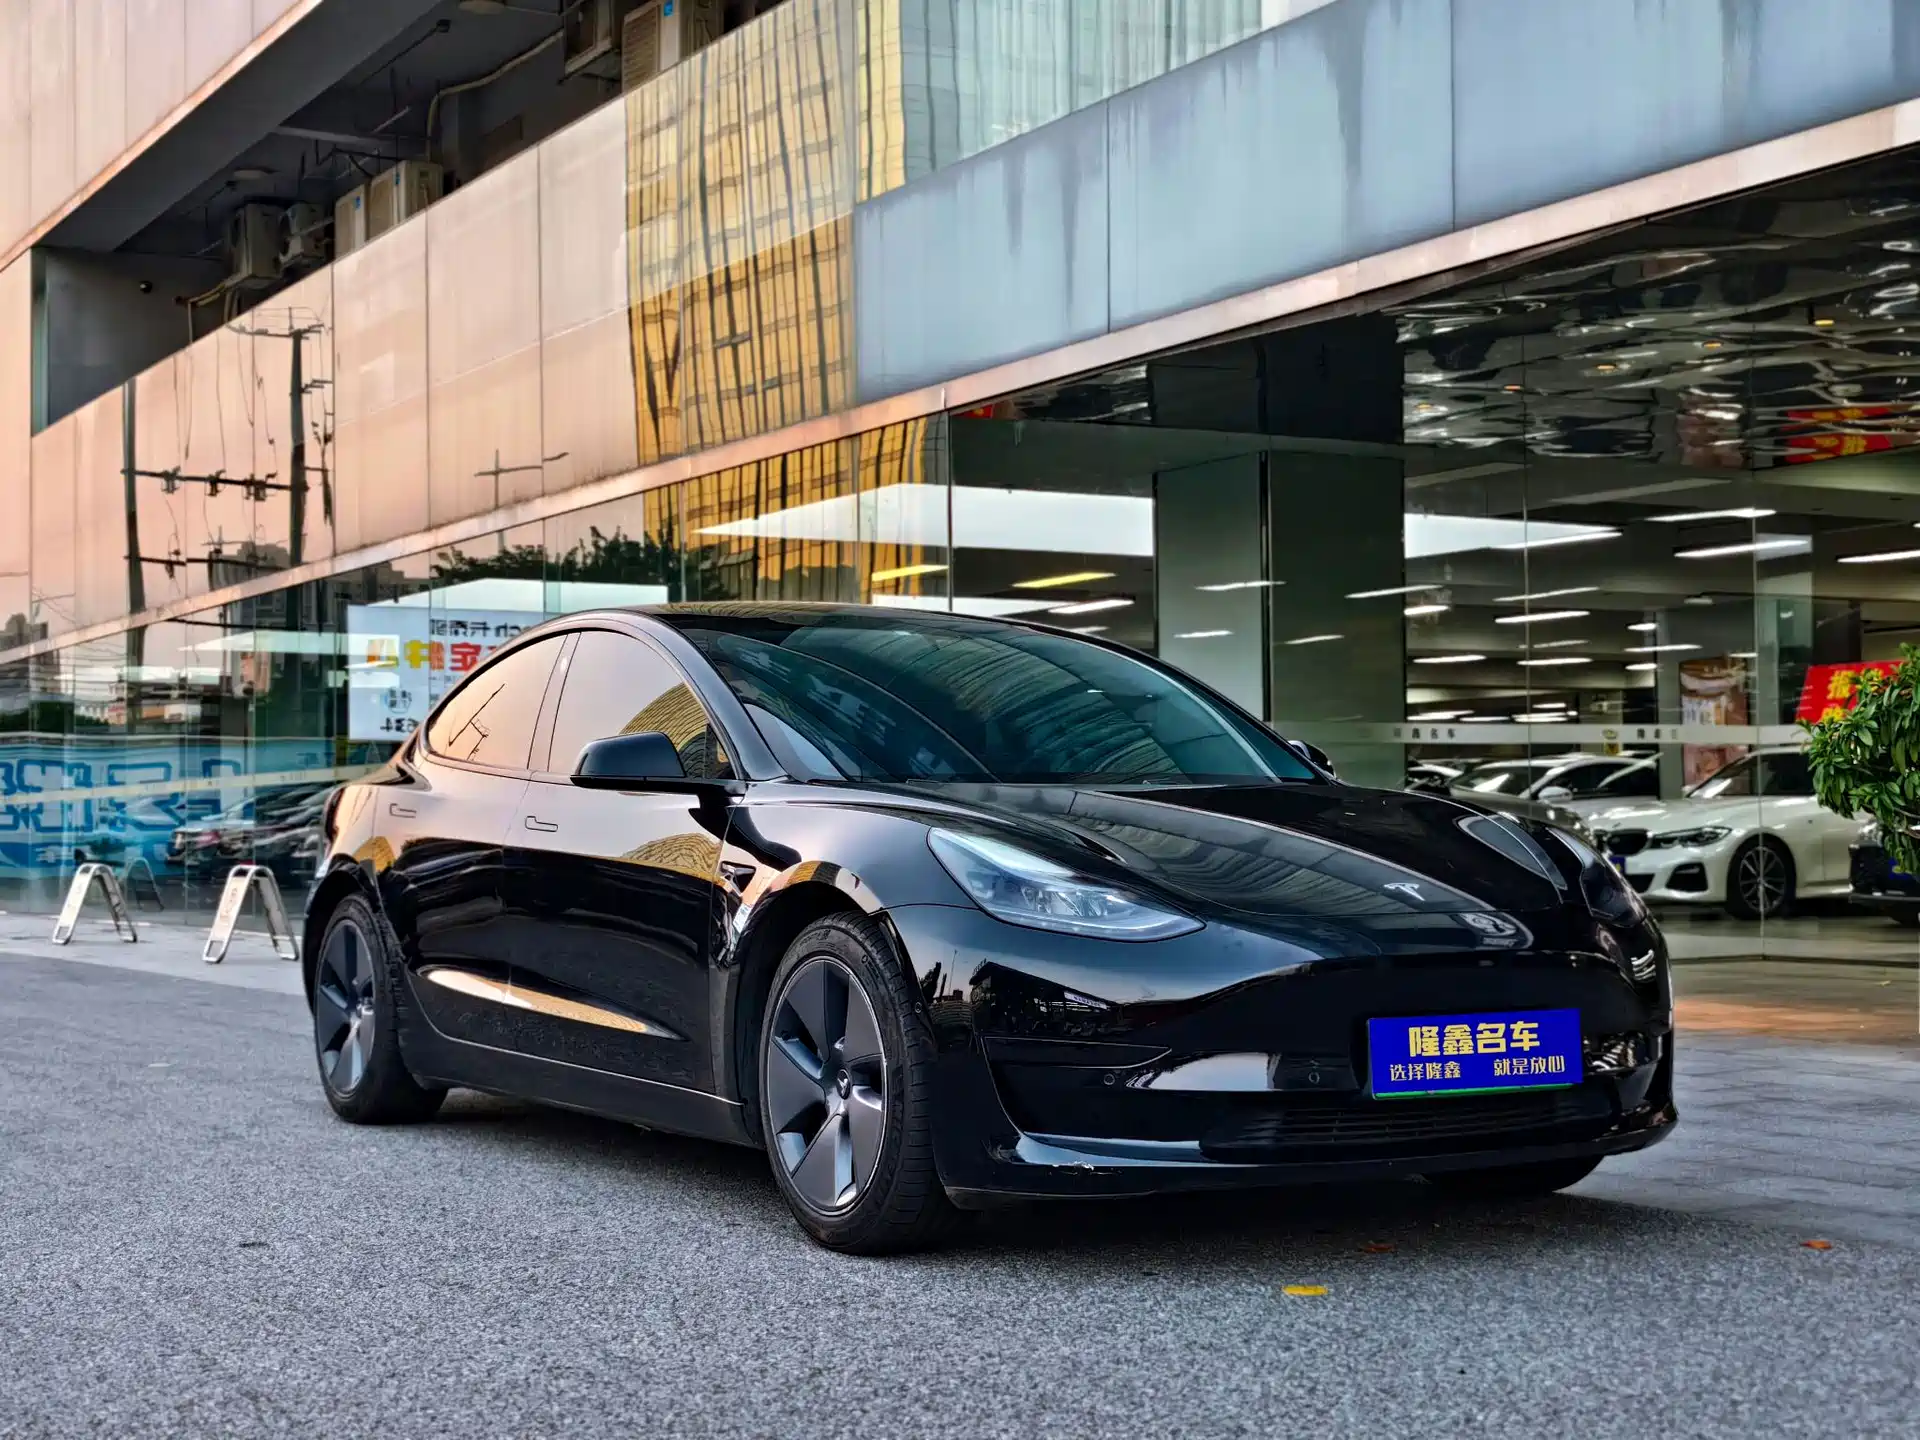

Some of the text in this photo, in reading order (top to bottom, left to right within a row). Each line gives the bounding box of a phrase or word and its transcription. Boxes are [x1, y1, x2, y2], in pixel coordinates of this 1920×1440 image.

[1408, 1020, 1541, 1058] 隆鑫名车
[1389, 1055, 1566, 1082] 选择隆鑫 就是放心
